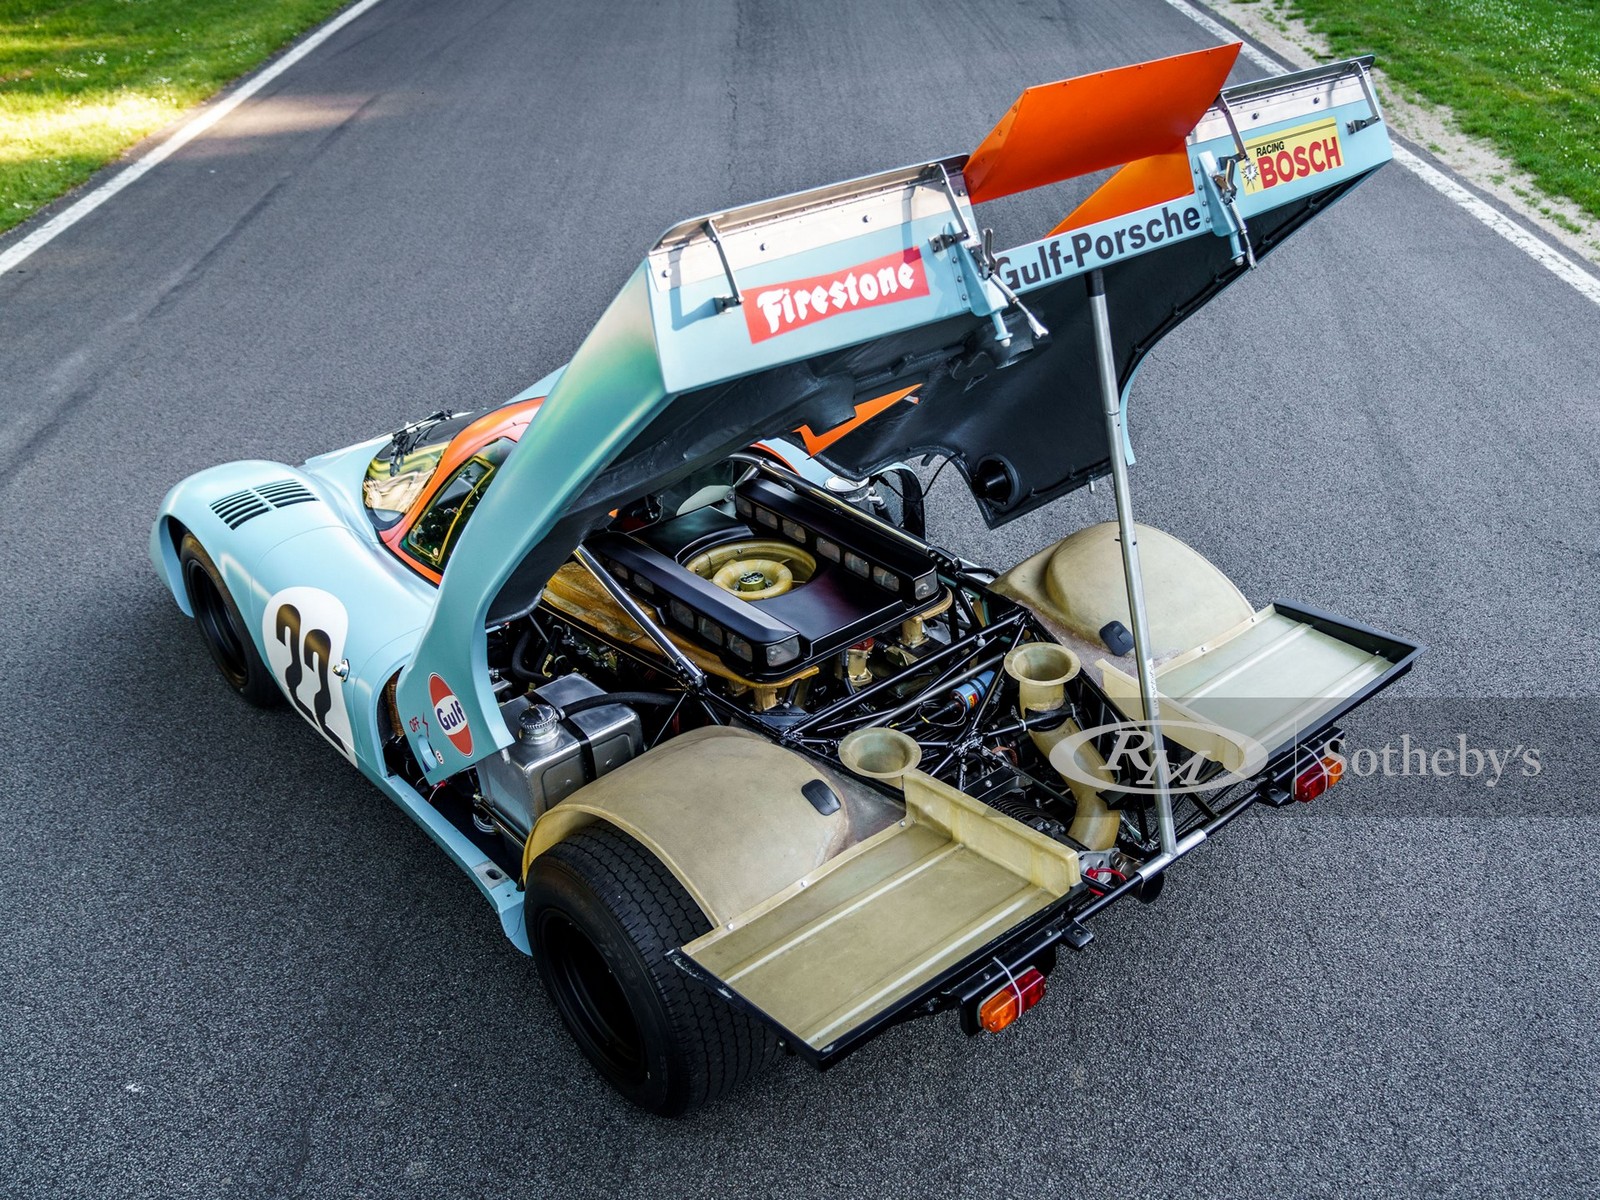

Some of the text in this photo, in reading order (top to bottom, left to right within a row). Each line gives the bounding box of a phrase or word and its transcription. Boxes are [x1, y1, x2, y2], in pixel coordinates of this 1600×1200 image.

[1256, 141, 1285, 157] RACING
[1257, 136, 1342, 189] BOSCH
[995, 206, 1201, 291] Gulf-Porsche
[756, 262, 914, 334] Firestone
[275, 603, 349, 756] 22
[436, 700, 466, 731] Gulf
